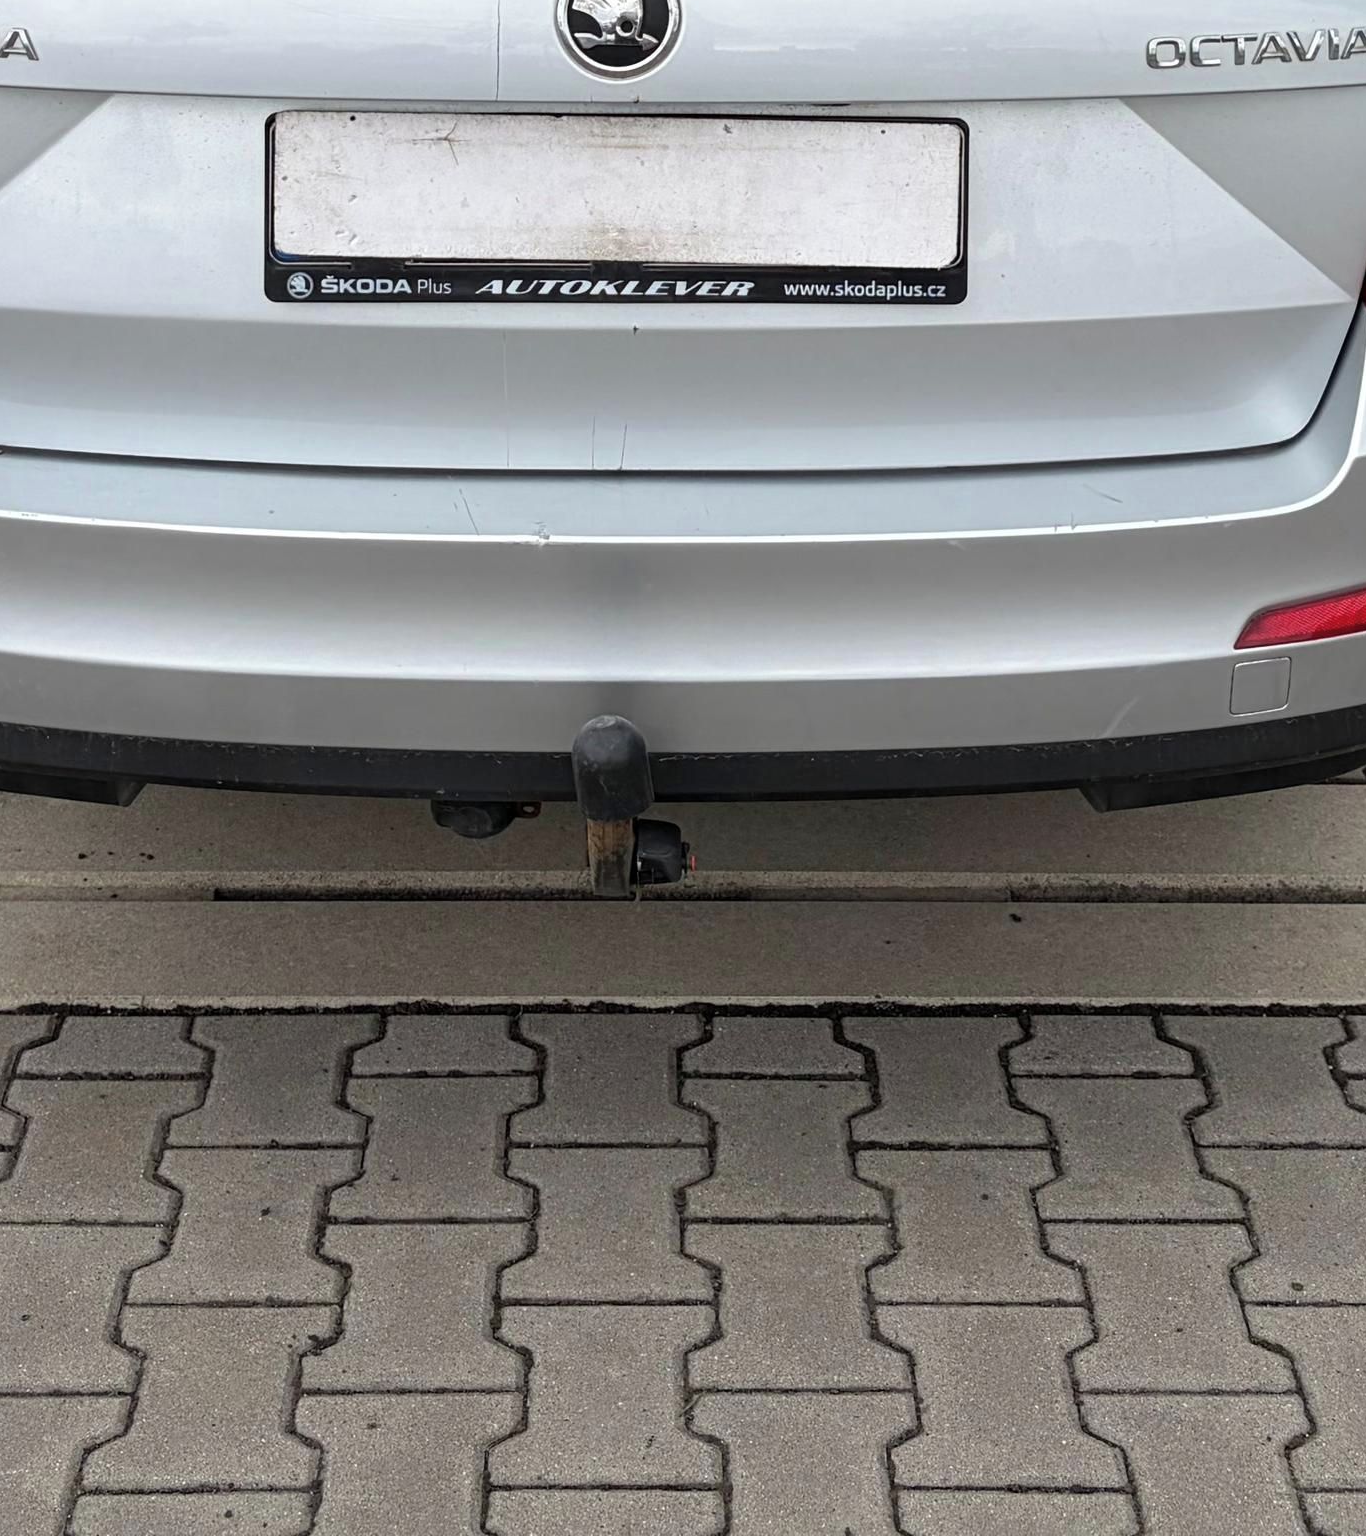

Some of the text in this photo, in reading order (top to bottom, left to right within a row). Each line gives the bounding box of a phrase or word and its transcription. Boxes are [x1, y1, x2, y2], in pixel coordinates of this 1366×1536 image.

[320, 275, 947, 301] ŠKODA Plus AUTOKLEVER www.skodaplus.cz
